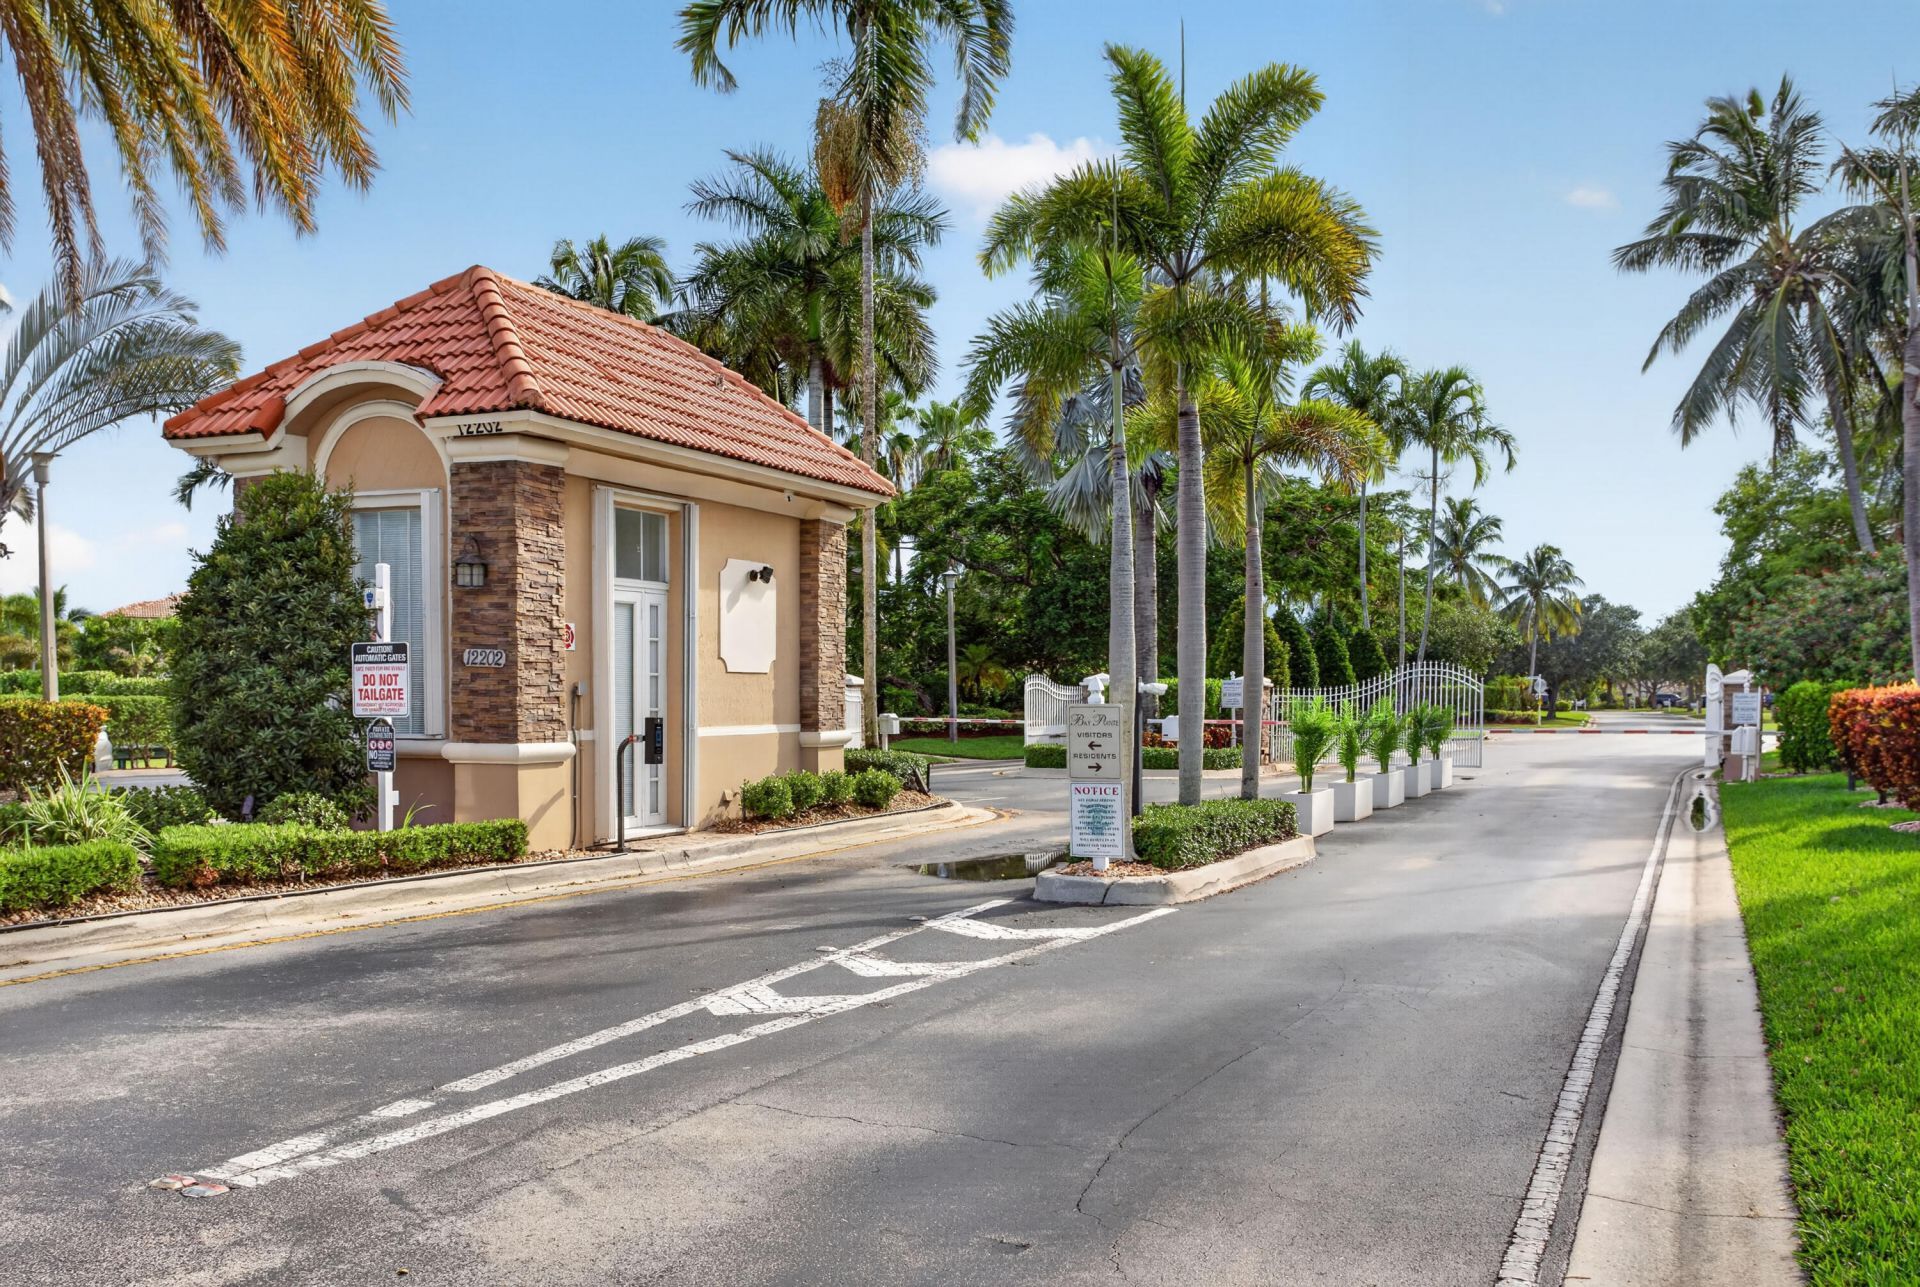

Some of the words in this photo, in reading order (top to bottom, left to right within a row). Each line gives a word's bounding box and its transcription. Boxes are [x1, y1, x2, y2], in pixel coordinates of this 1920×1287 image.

[366, 645, 393, 654] CAUTION!
[355, 654, 387, 662] AUTOMATIC
[387, 653, 406, 662] GATES
[466, 649, 504, 666] 12202
[362, 674, 376, 686] DO
[379, 673, 399, 686] NOT
[358, 688, 404, 701] TAILGATE
[368, 750, 378, 760] NO
[1074, 786, 1119, 796] NOTICE
